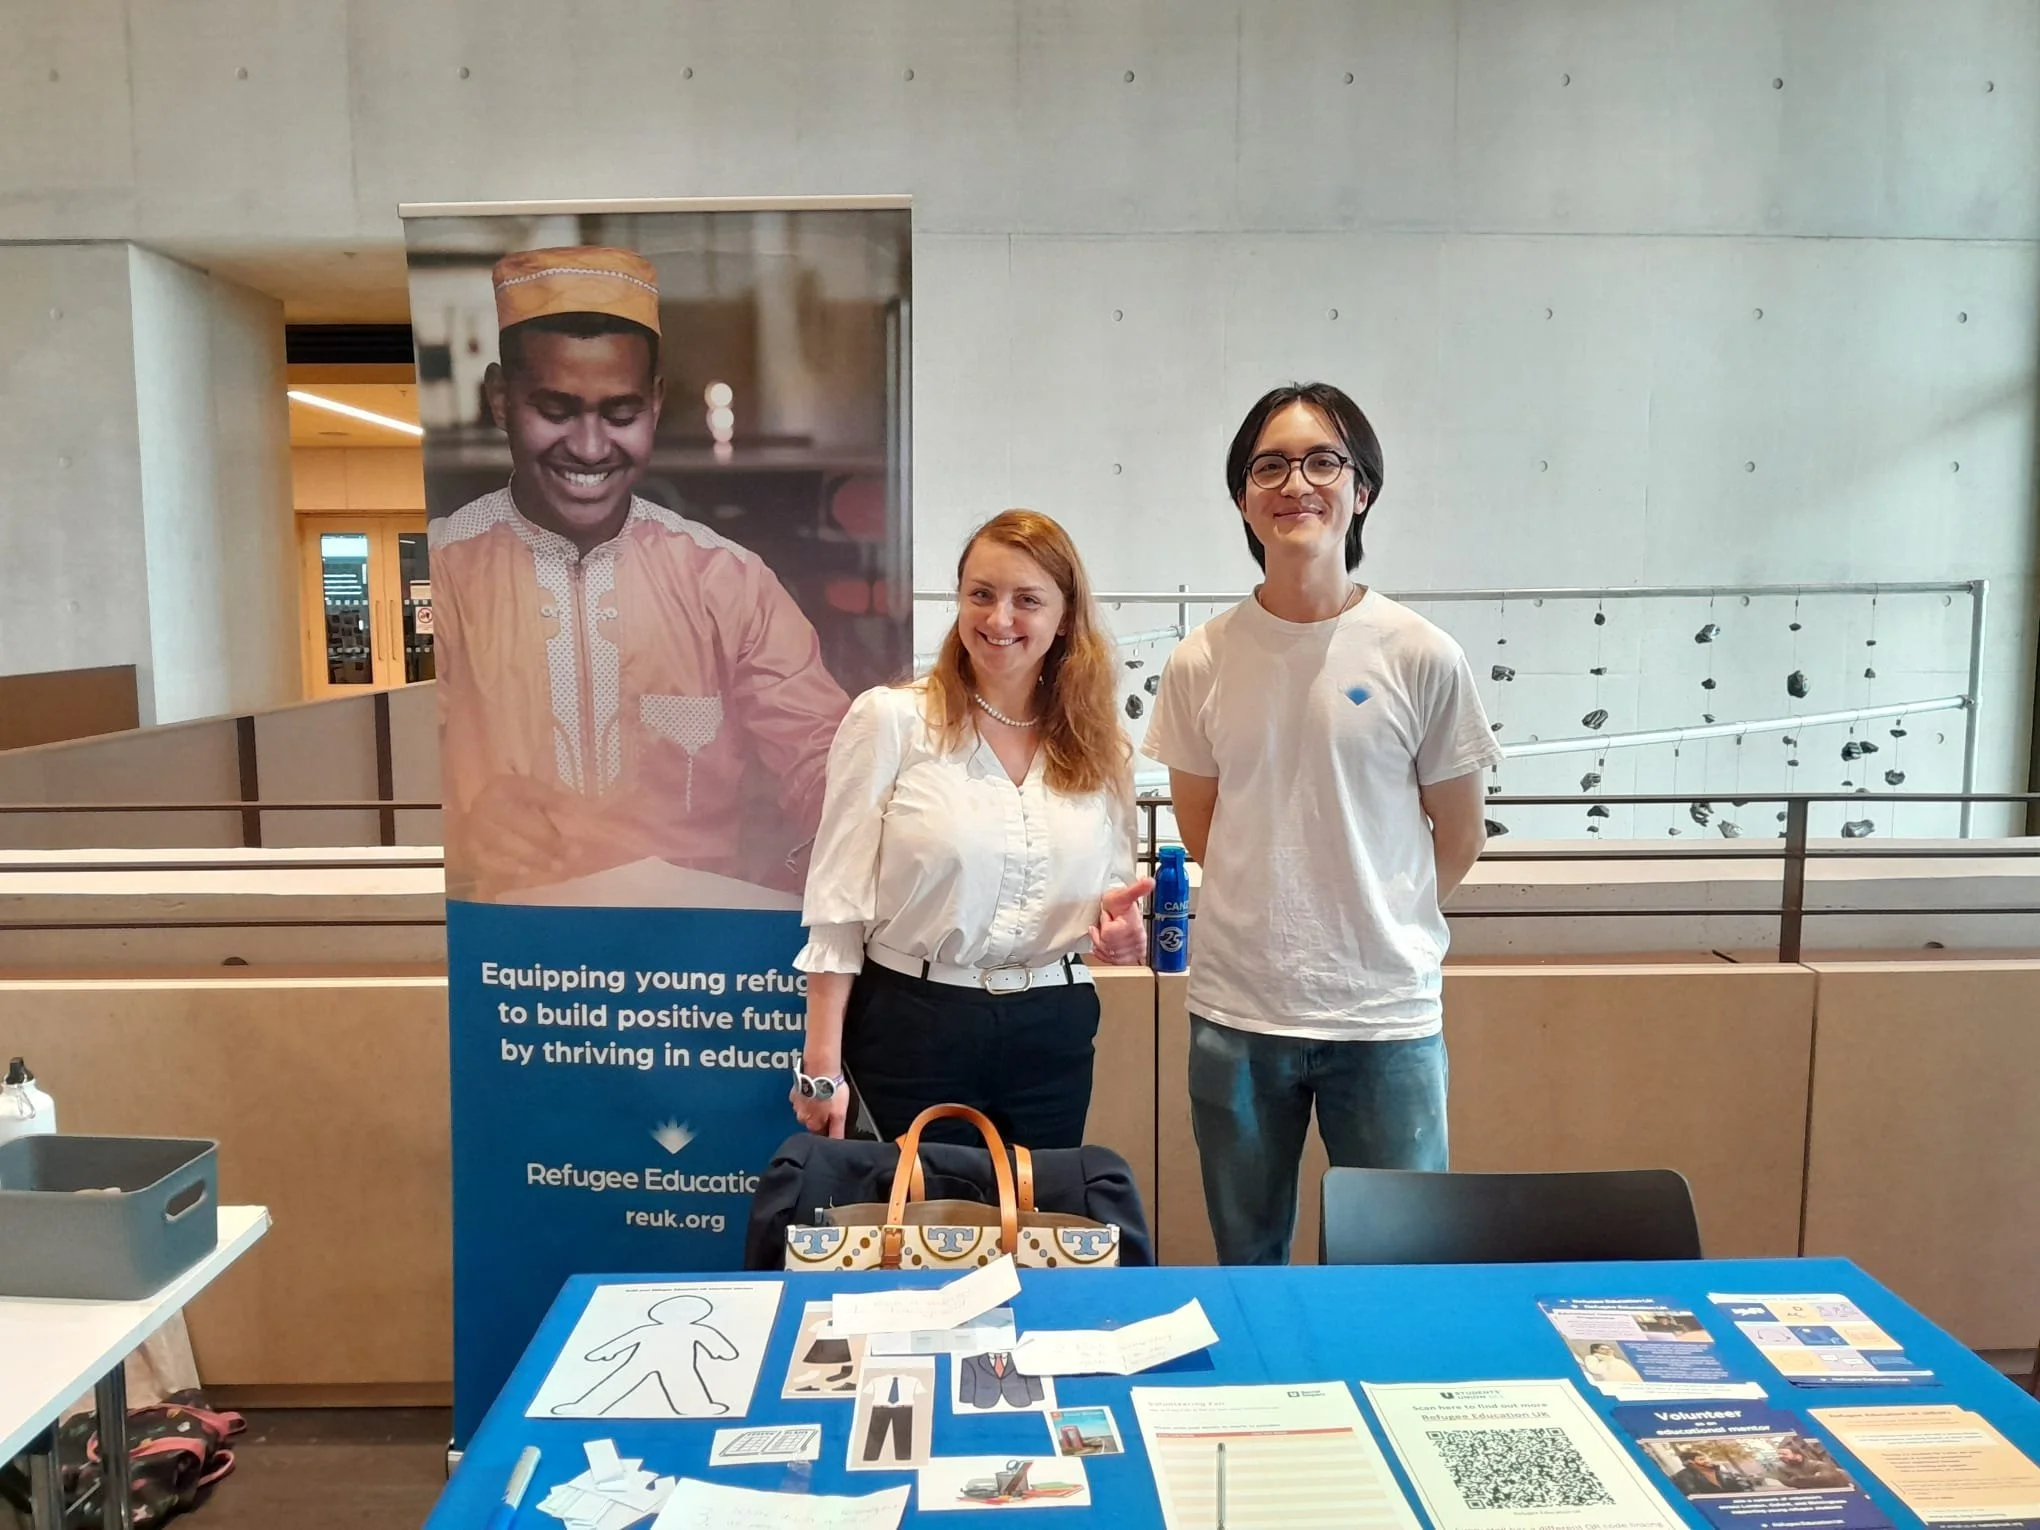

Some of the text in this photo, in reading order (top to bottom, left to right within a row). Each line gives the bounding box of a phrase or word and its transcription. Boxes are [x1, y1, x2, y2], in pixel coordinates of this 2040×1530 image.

[482, 961, 625, 993] Equipping
[635, 971, 726, 996] young
[497, 1002, 808, 1032] to build positive futu
[501, 1038, 534, 1066] by
[542, 1040, 654, 1071] thriving
[664, 1041, 690, 1067] in
[527, 1163, 639, 1192] Refugee
[626, 1209, 726, 1233] reuk.org
[1471, 1412, 1530, 1420] Education
[1653, 1410, 1742, 1421] Volunteer
